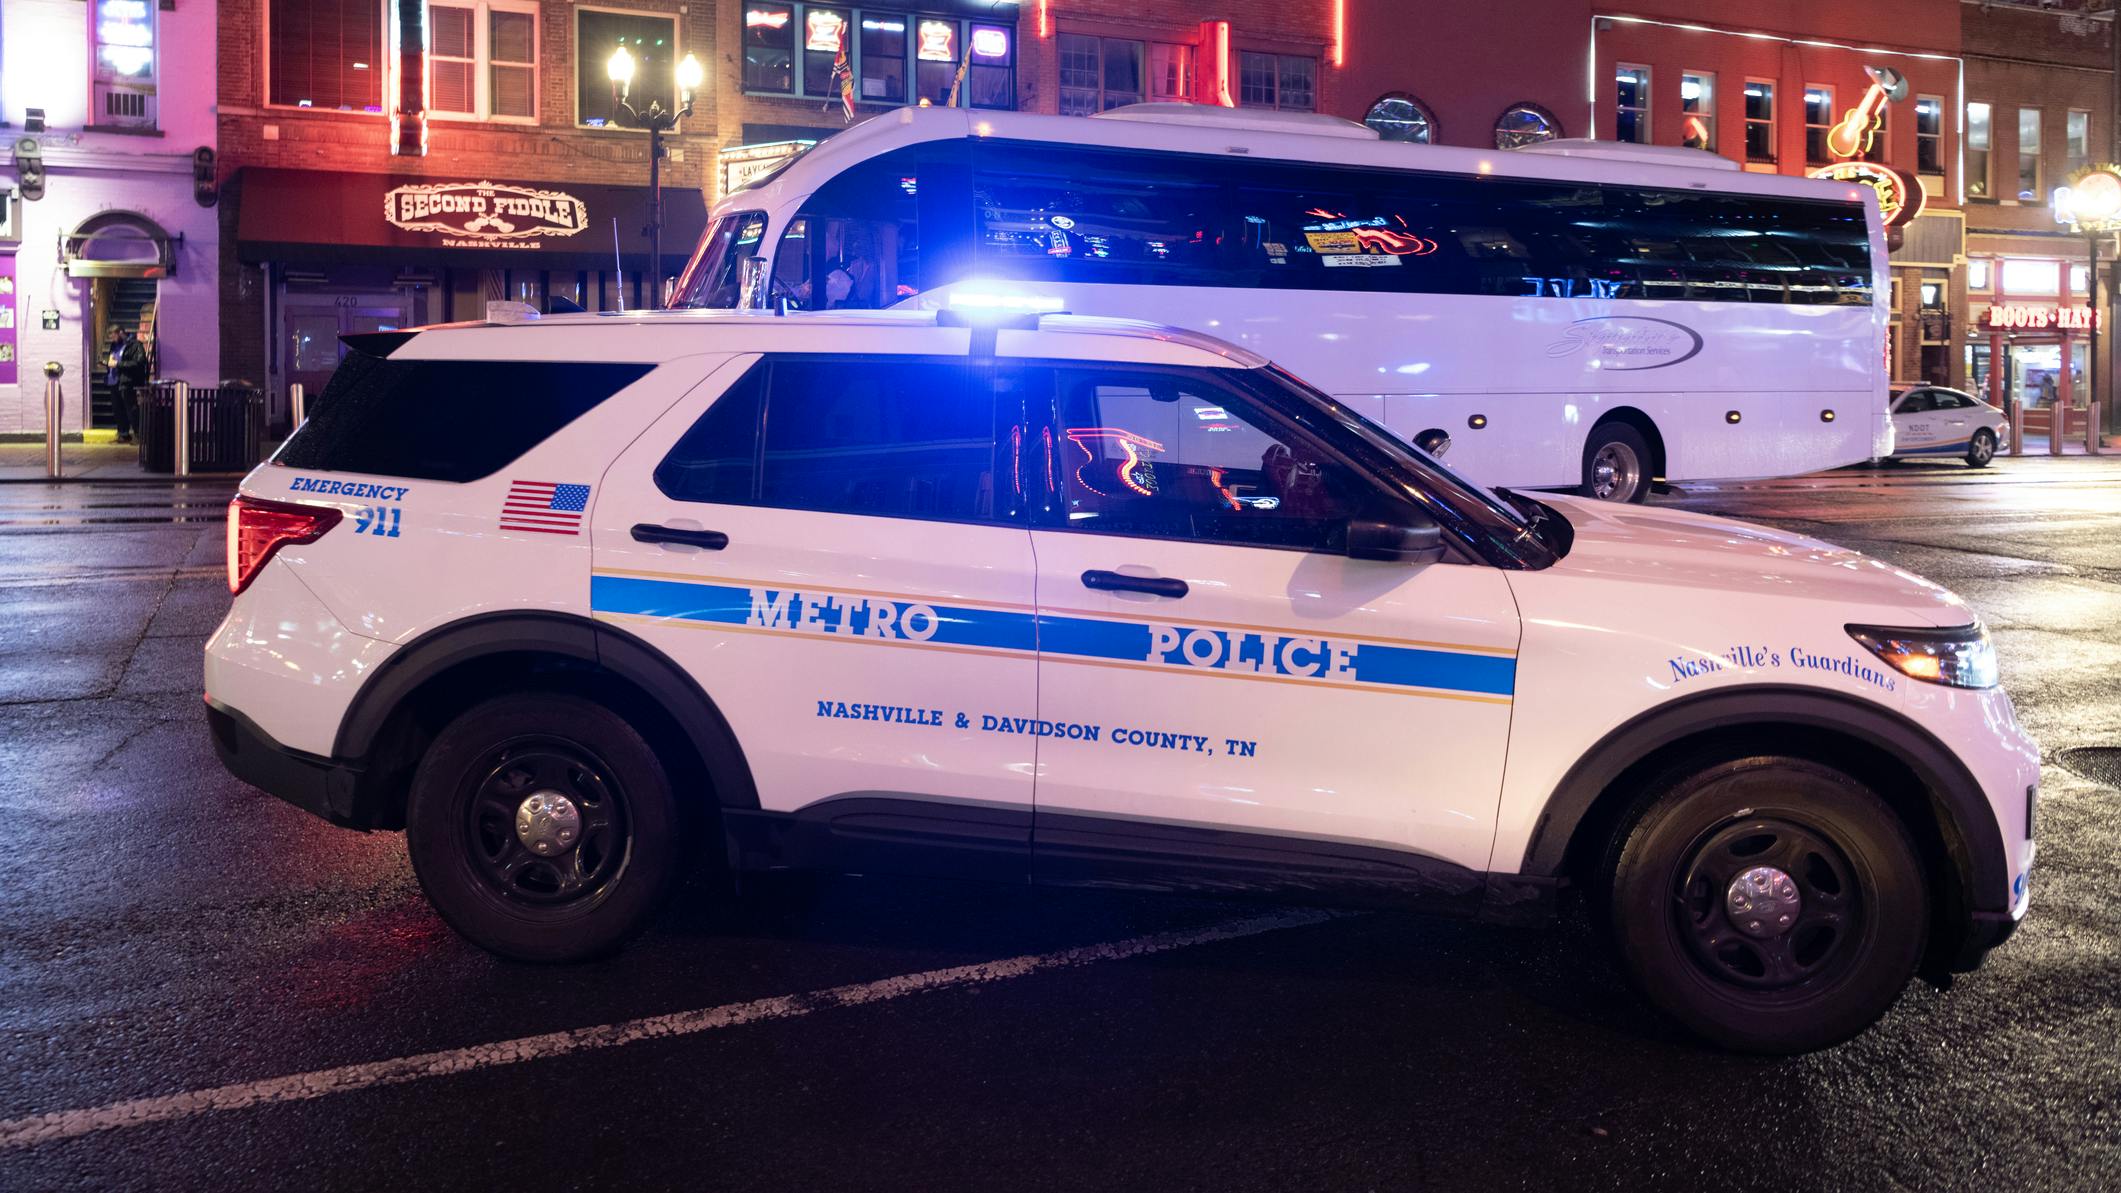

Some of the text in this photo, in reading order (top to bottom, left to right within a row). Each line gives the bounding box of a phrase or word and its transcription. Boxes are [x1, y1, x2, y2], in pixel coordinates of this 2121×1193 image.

[401, 194, 574, 229] SECOND FIDDLE
[442, 239, 541, 249] NASHVILLE
[335, 296, 358, 308] 420
[1990, 306, 2048, 328] BOOTS
[290, 477, 410, 501] EMERGENCY
[354, 506, 401, 538] 911
[746, 588, 1360, 680] METRO POLICE
[1790, 647, 1896, 692] Guardians
[817, 700, 1258, 757] NASHVILLE & DAVIDSON COUNTY, TN
